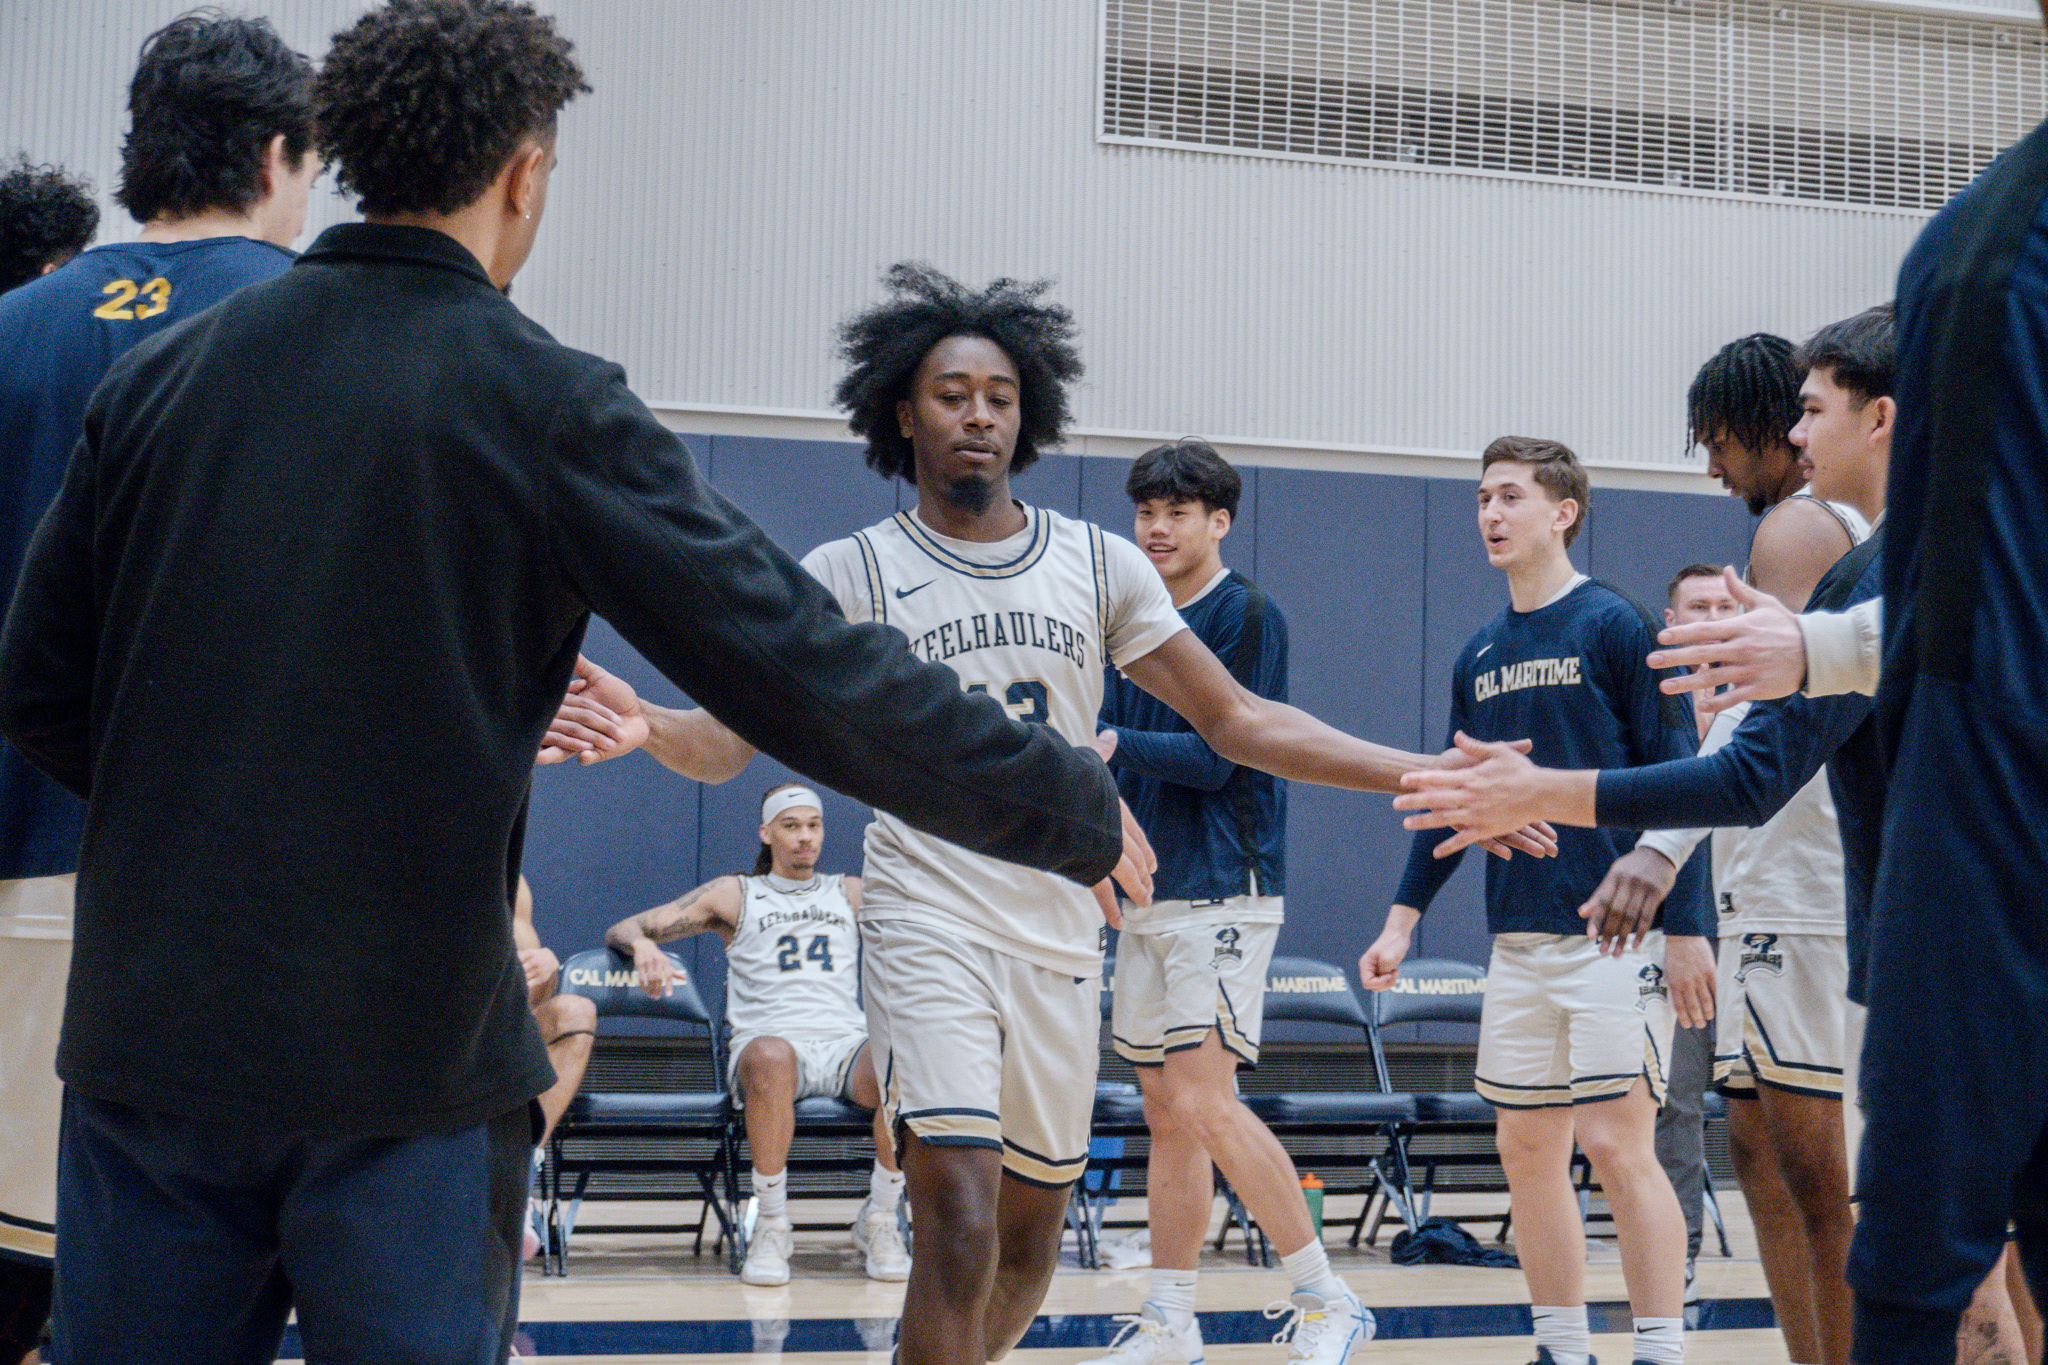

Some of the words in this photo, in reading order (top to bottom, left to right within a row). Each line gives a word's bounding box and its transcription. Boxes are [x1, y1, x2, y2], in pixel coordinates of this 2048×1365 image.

[93, 277, 172, 320] 23
[1475, 670, 1500, 702] CAL
[1501, 657, 1581, 693] MARITIME
[965, 677, 1053, 727] 3
[776, 934, 835, 973] 24
[569, 968, 603, 987] CAL
[1271, 976, 1348, 993] MARITIME
[1390, 977, 1419, 993] CAL
